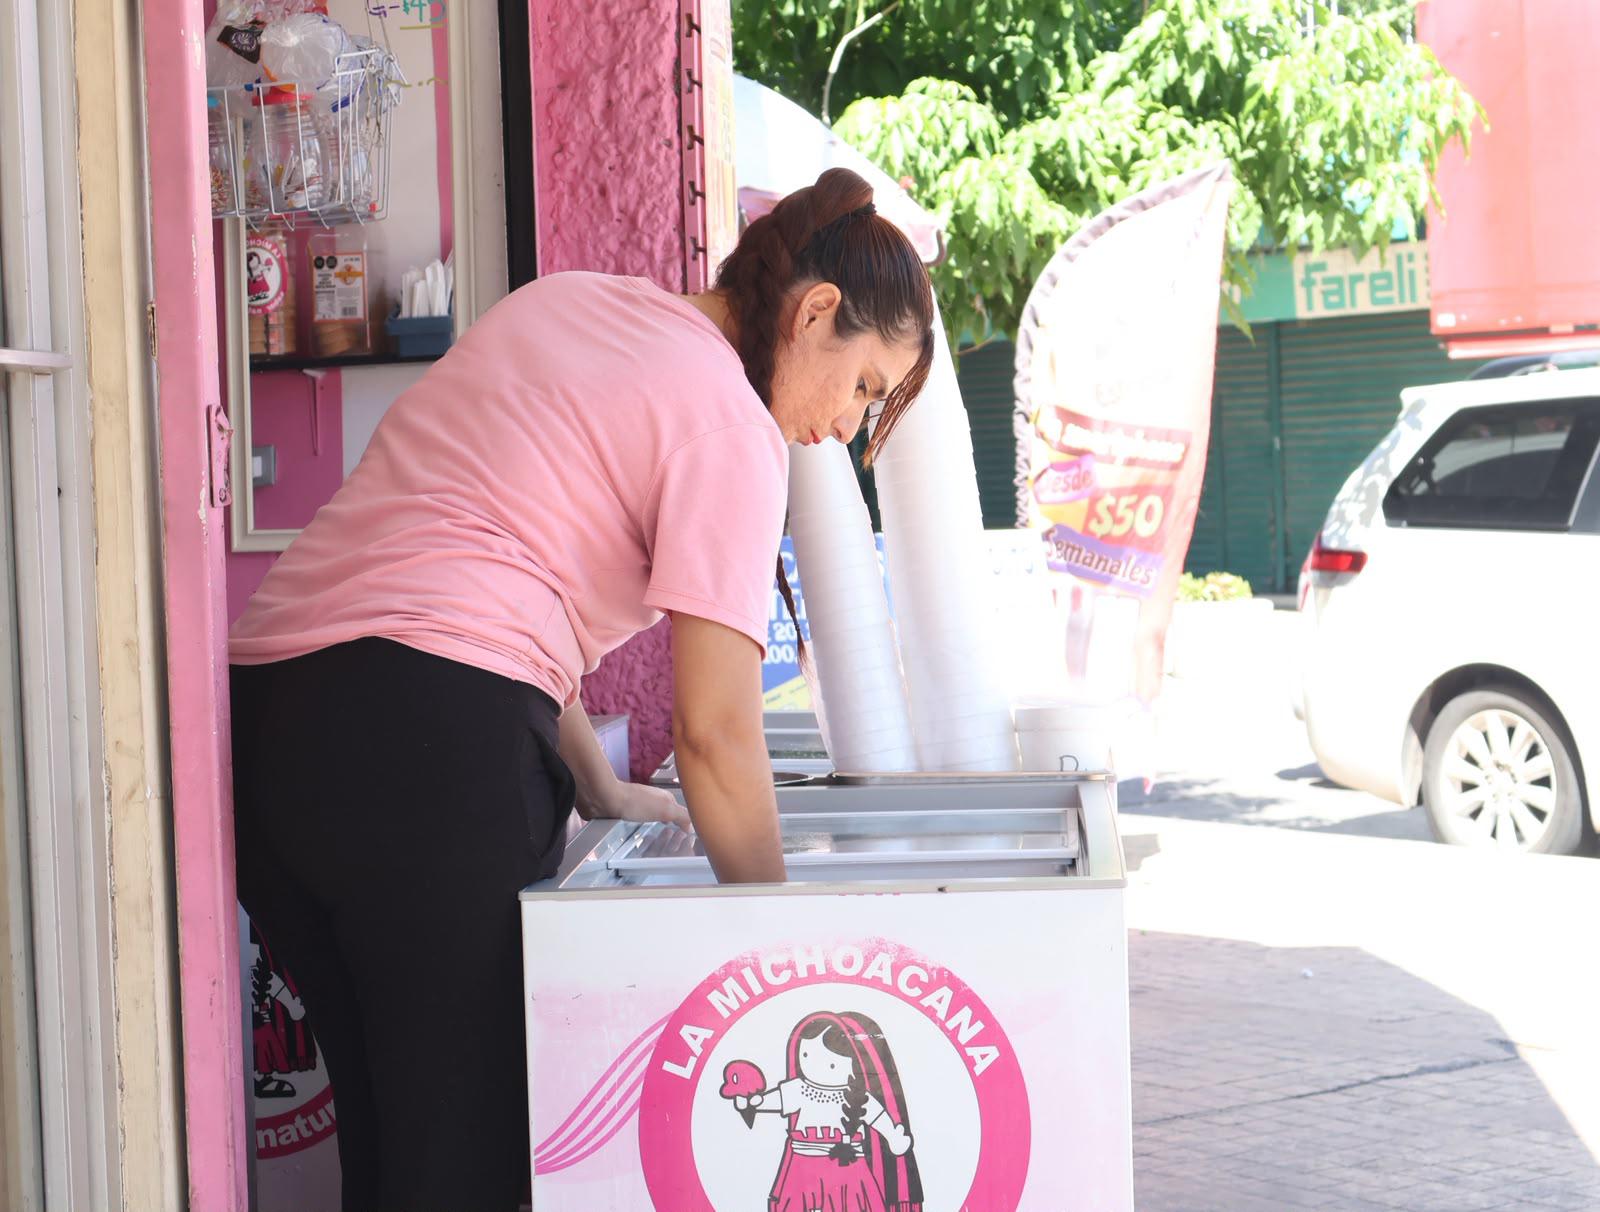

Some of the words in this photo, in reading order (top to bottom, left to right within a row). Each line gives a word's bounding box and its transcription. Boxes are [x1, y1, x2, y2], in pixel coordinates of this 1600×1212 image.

[1301, 252, 1417, 312] fareli
[1040, 463, 1094, 499] esde
[1087, 492, 1164, 540] $50
[1042, 526, 1154, 588] Semanales
[662, 1023, 714, 1080] LA
[706, 945, 1000, 1076] MICHOACANA
